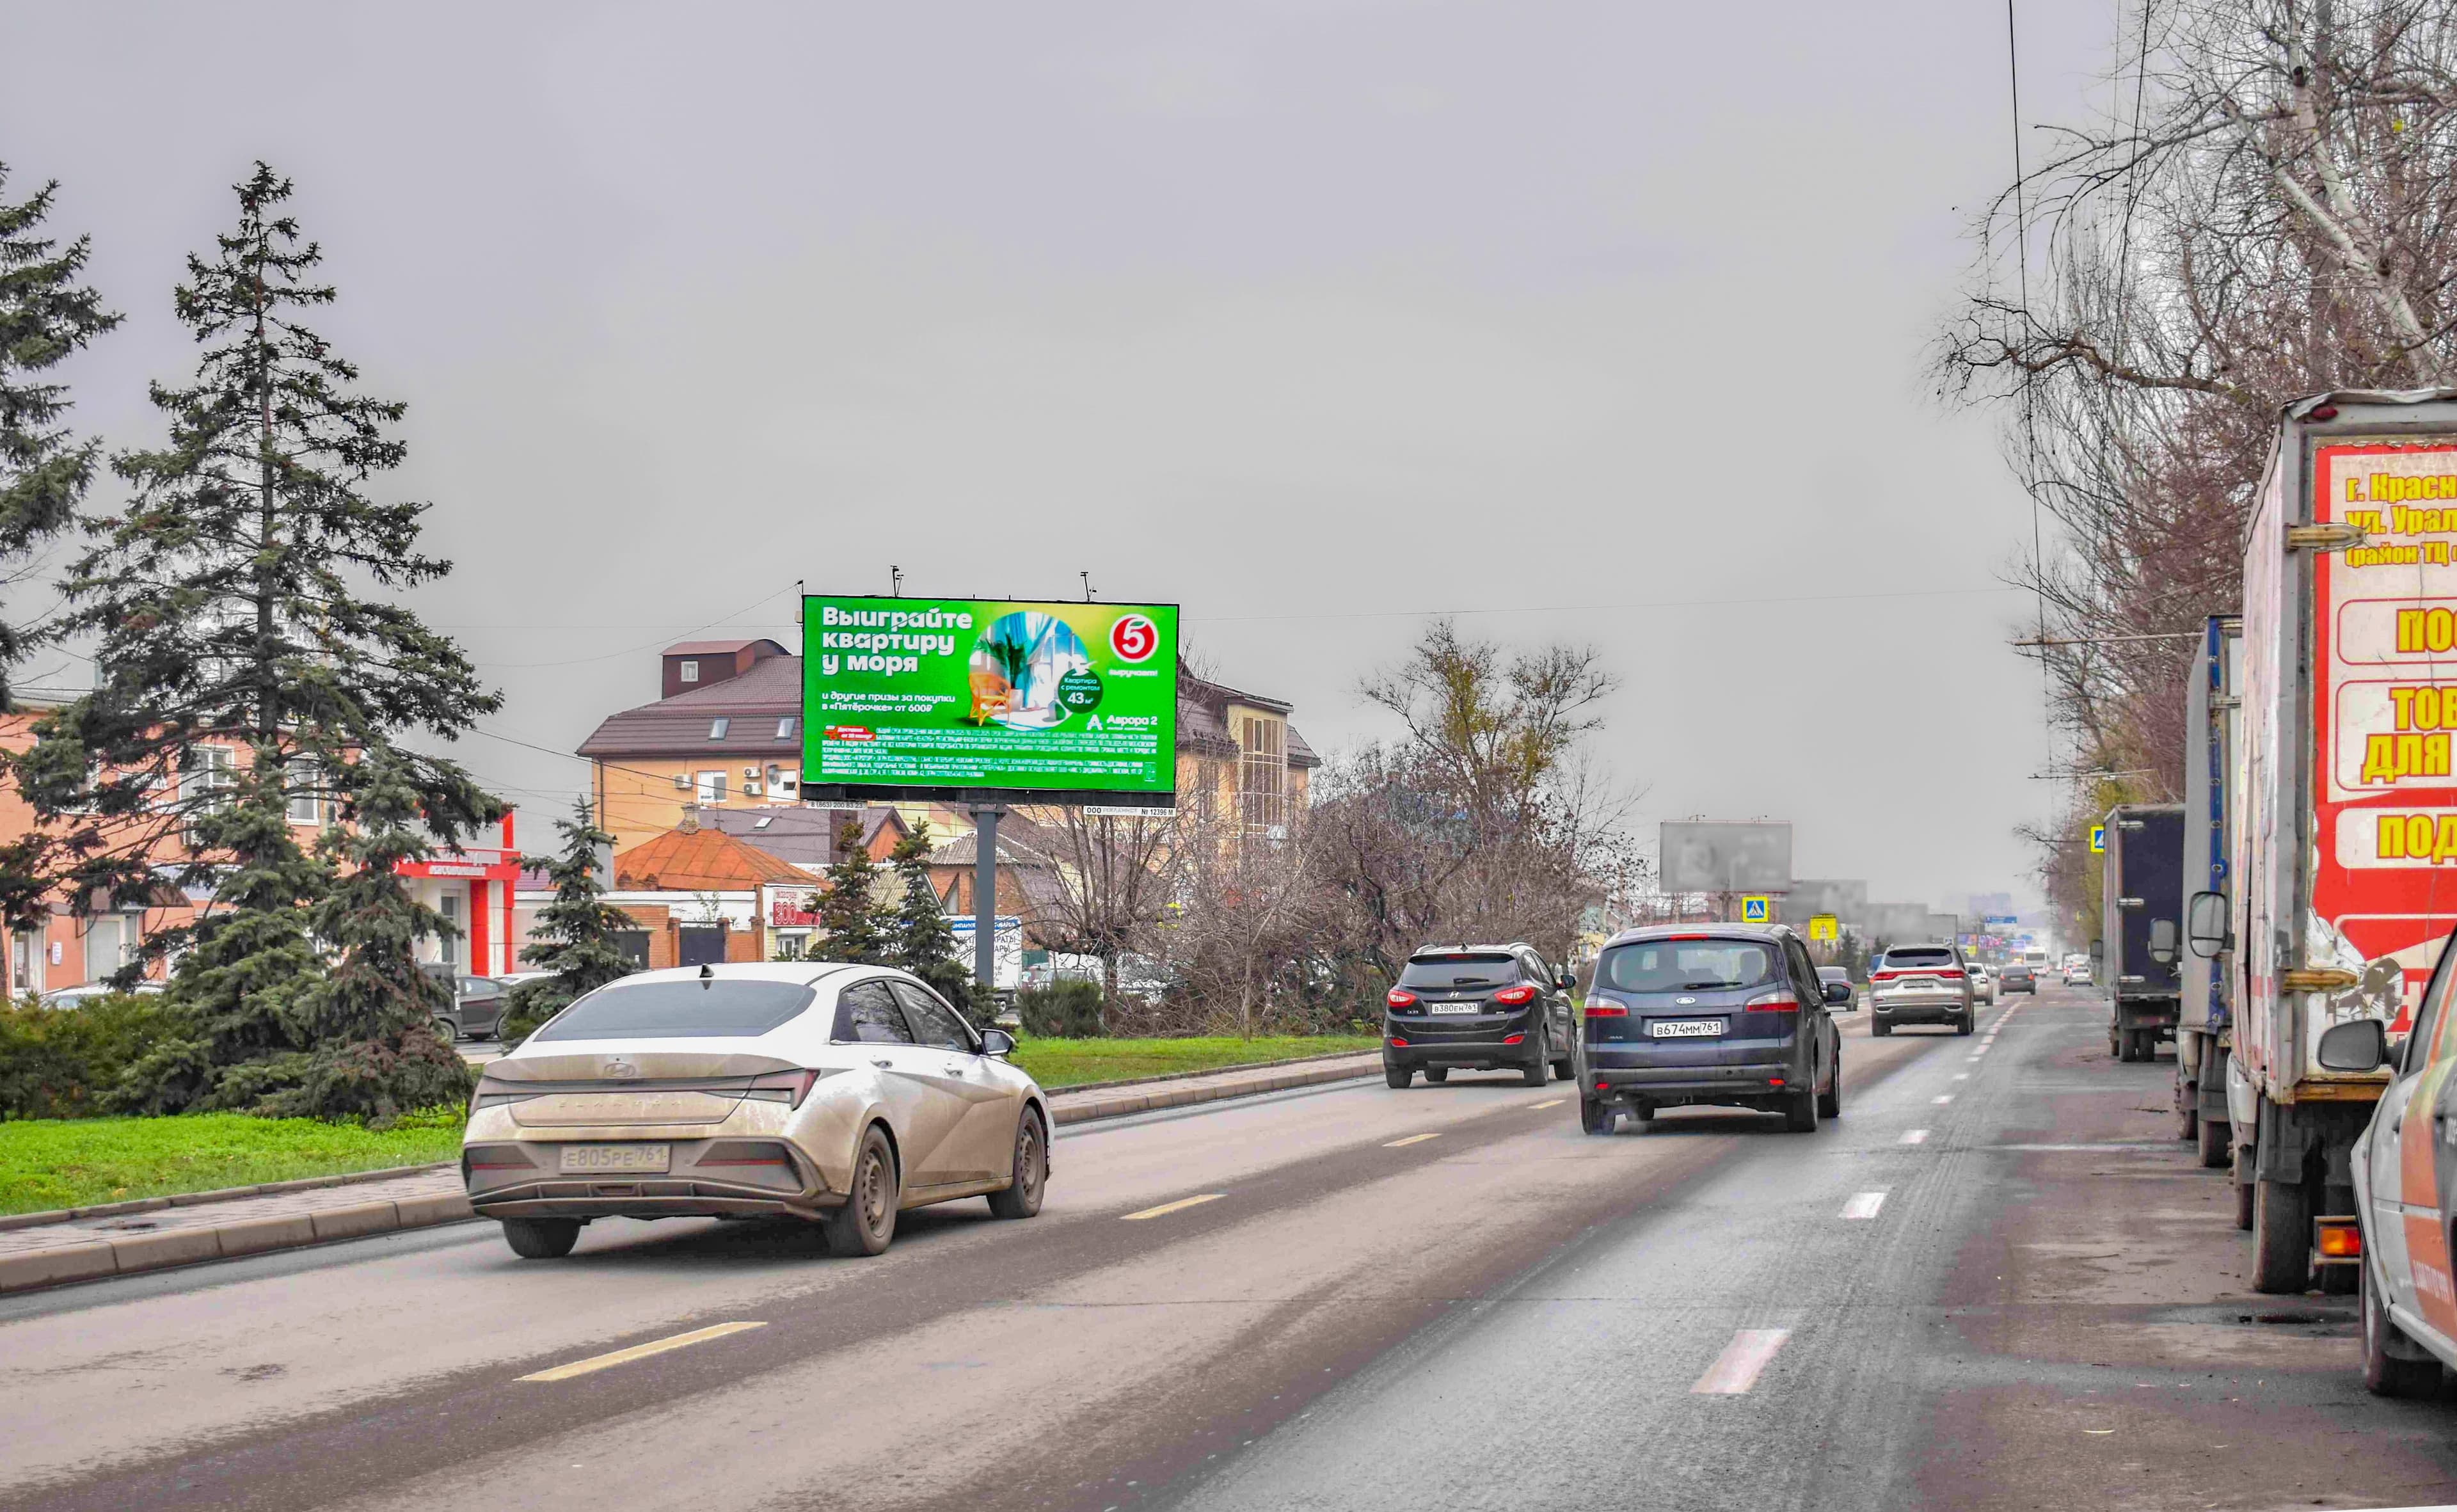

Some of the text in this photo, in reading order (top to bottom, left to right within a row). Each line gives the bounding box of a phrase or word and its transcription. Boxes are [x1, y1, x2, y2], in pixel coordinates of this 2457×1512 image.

[2346, 473, 2457, 504] г. Красн
[2344, 505, 2457, 536] ул. Урал
[2421, 541, 2449, 566] ТЦ
[823, 607, 973, 632] Выиграйте
[2396, 607, 2457, 653] ПО
[823, 632, 955, 656] квартиру
[822, 654, 918, 676] у моря
[829, 703, 893, 712] «Пятёрочке»
[831, 691, 866, 702] другие
[868, 694, 899, 703] призы
[914, 696, 956, 704] покупки
[1067, 692, 1085, 704] 43
[1107, 715, 1157, 727] Аврора 2
[2360, 732, 2451, 784] ДЛЯ
